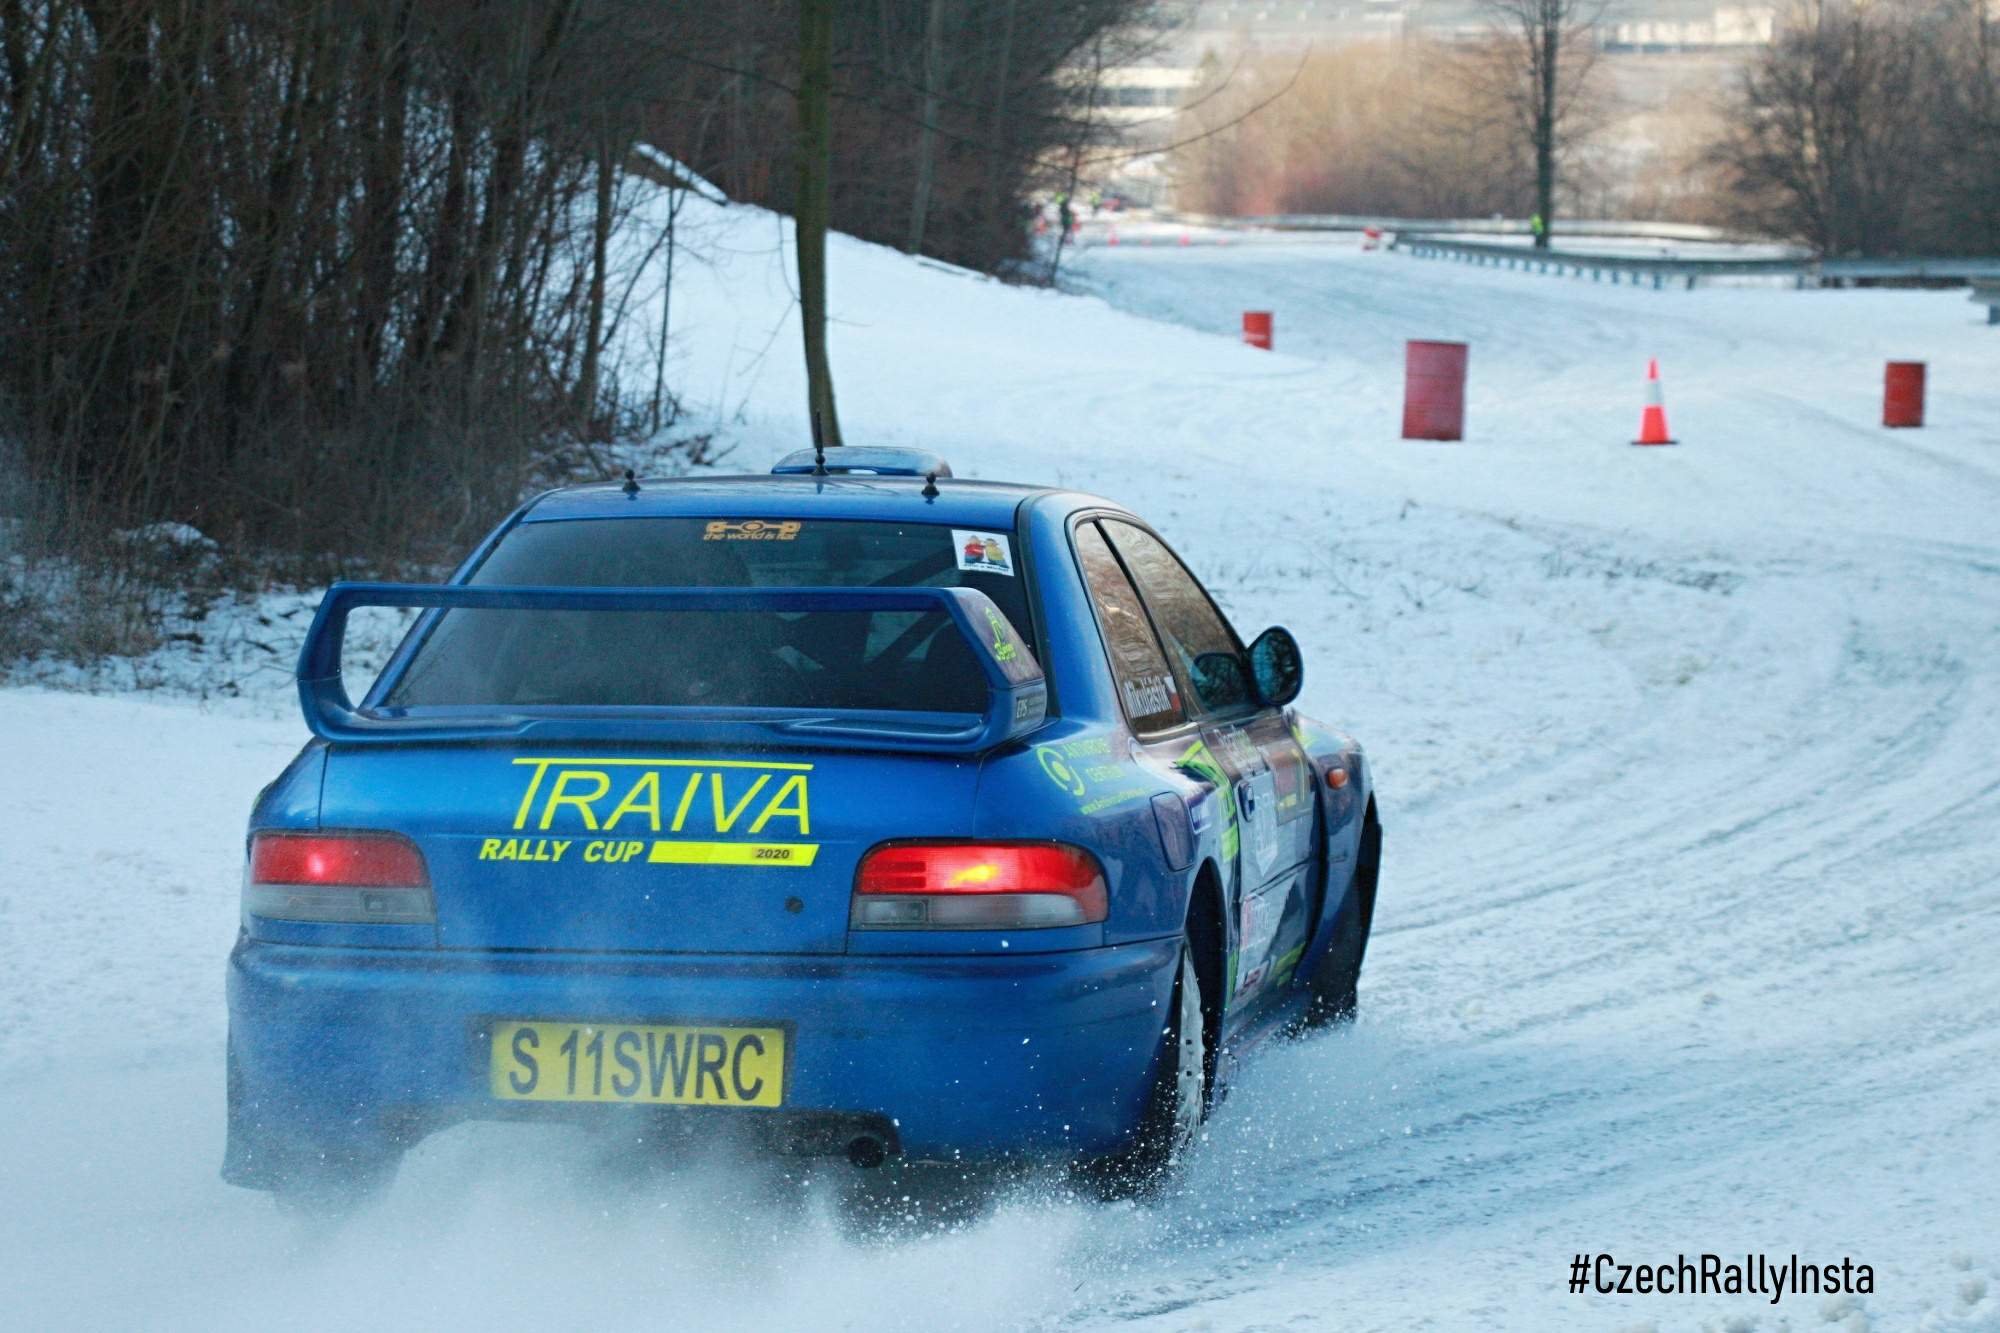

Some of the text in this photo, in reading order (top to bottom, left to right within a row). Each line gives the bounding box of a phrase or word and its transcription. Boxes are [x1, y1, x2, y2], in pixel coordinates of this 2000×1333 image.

[704, 532, 725, 540] the
[727, 531, 765, 540] world
[512, 758, 815, 834] TRAIVA
[478, 839, 791, 863] RALLY CUP 2020
[508, 1027, 766, 1101] S 11SWRC
